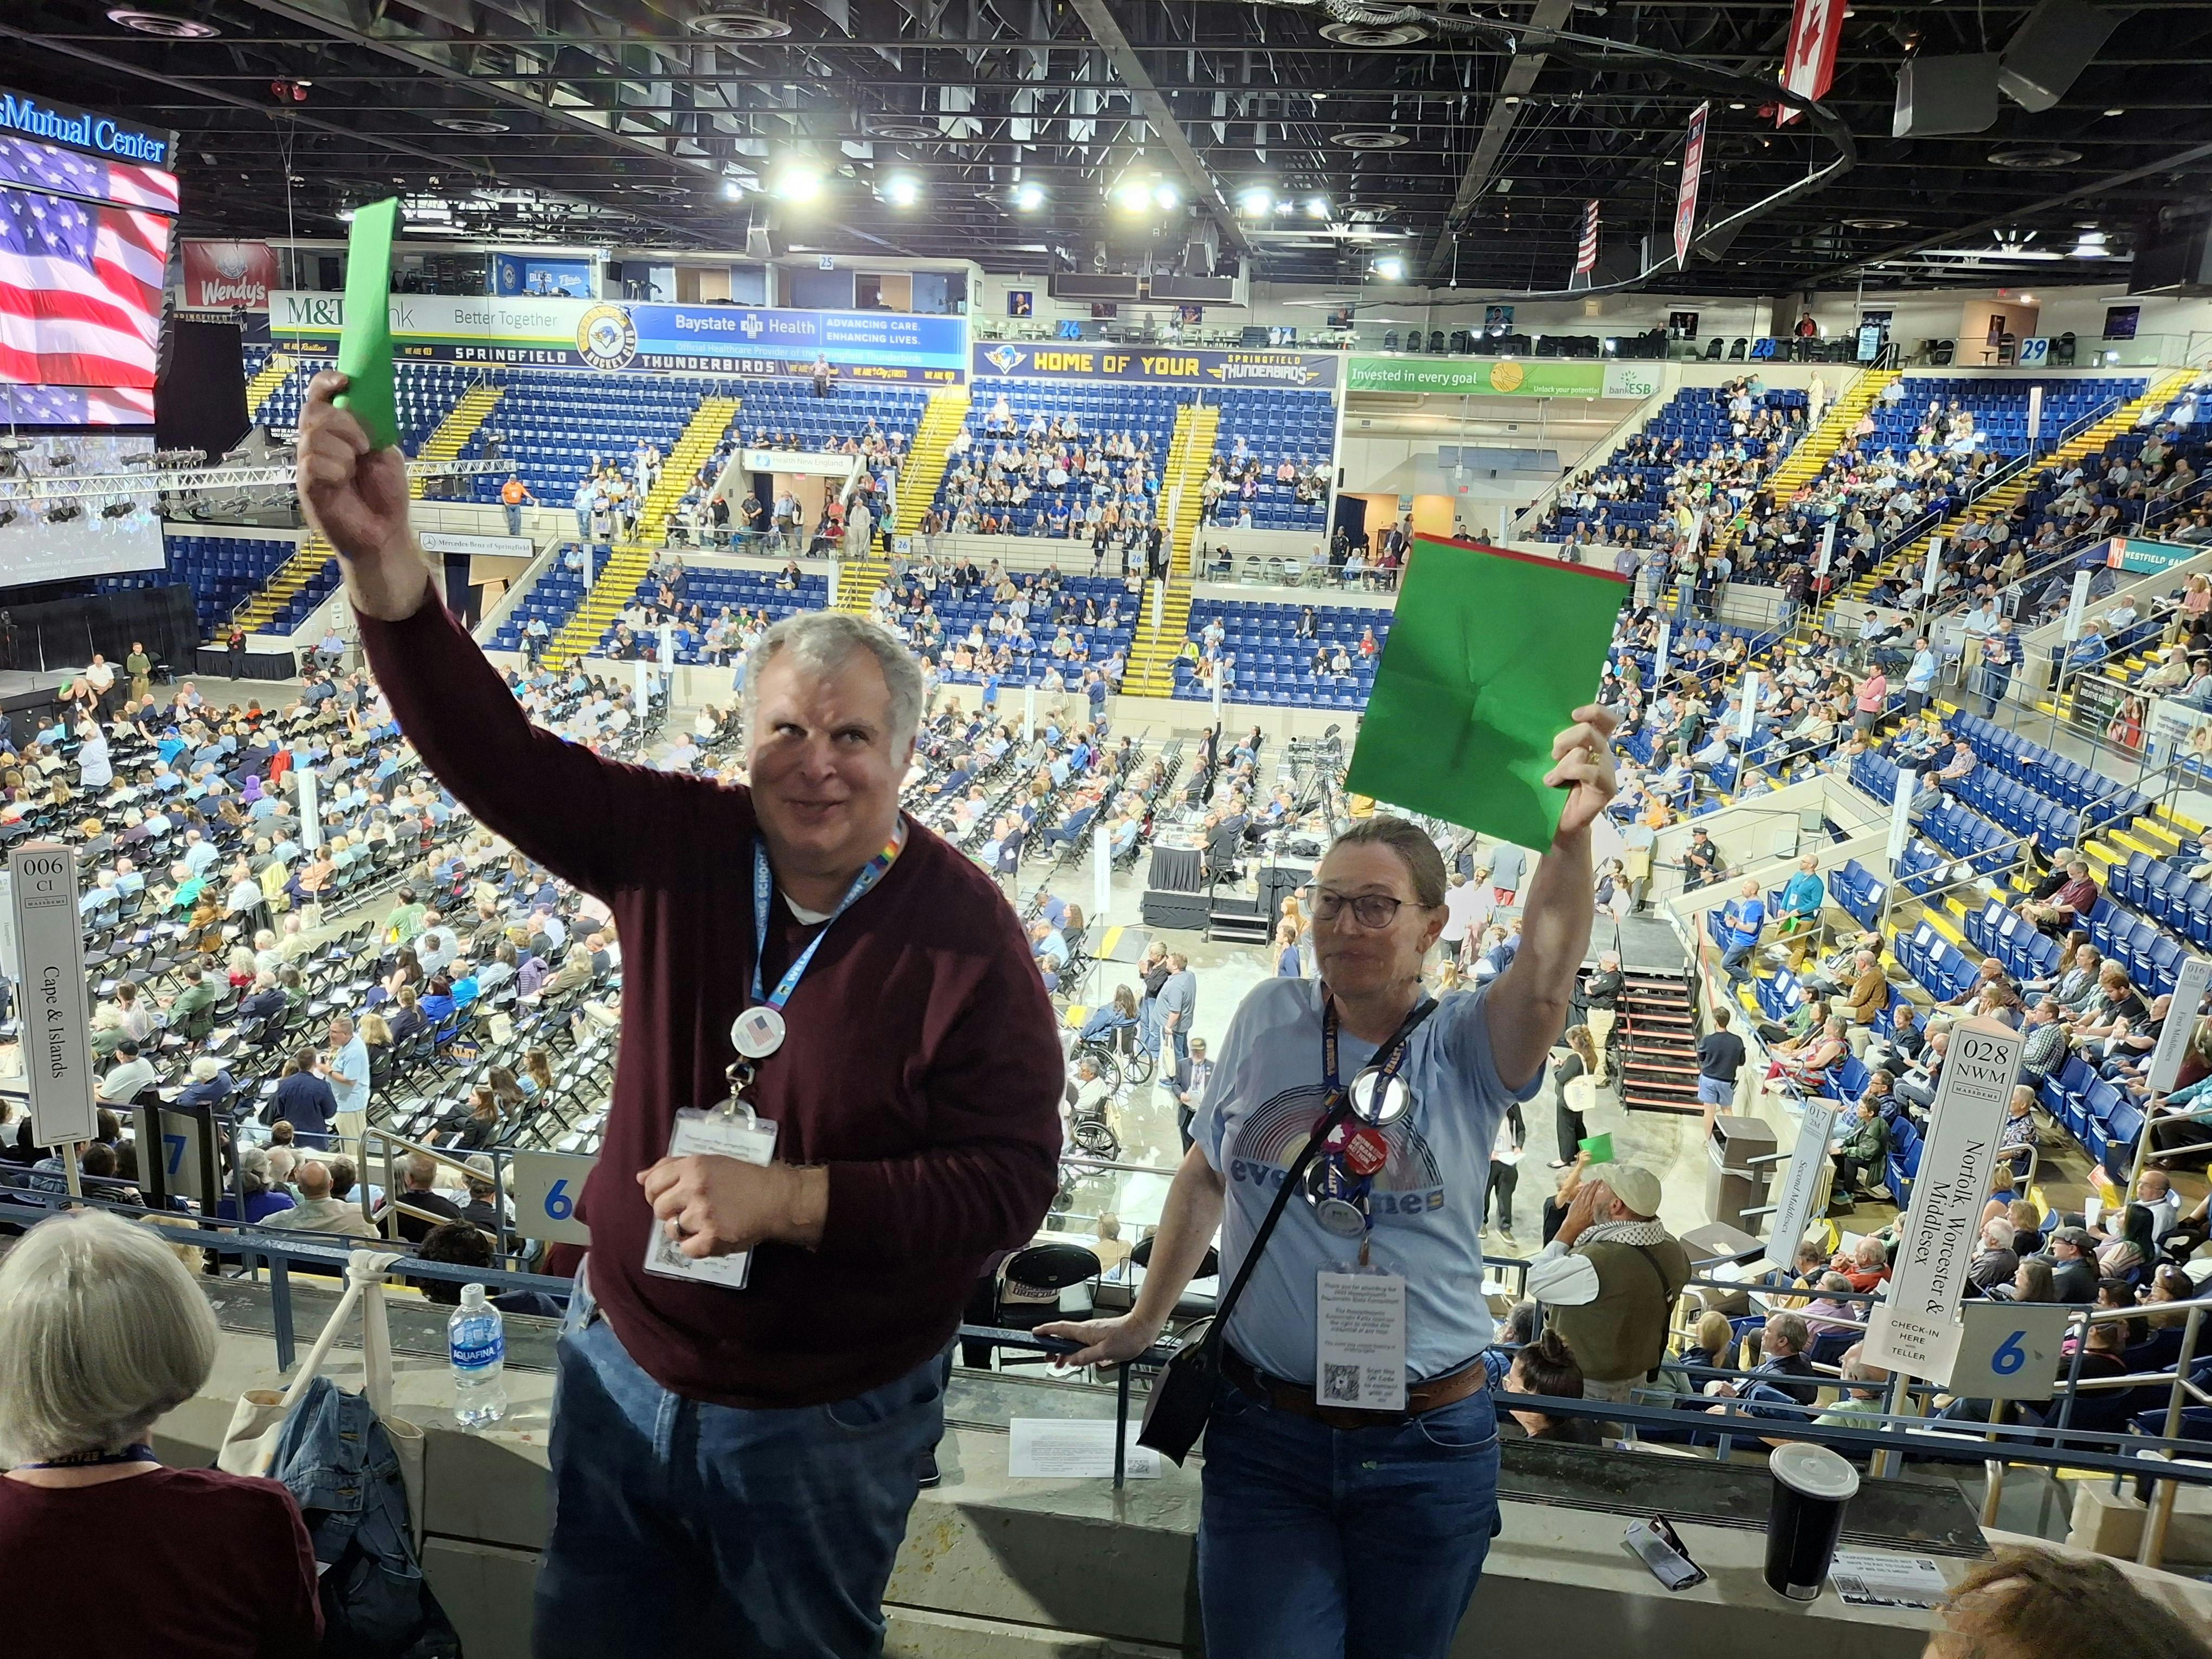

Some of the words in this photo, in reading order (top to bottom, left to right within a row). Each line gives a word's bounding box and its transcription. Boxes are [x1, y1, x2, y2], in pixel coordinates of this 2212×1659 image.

[95, 120, 165, 163] Center
[599, 249, 609, 259] 24
[821, 256, 833, 268] 25
[201, 275, 266, 307] Wendy's
[389, 301, 415, 329] nk
[454, 310, 496, 325] Better
[499, 311, 558, 329] Together
[827, 318, 888, 330] ADVANCING
[676, 314, 736, 333] Baystate
[769, 319, 815, 335] Health
[1060, 320, 1081, 338] 26
[827, 332, 887, 343] ENHANCING
[1270, 326, 1293, 345] 27
[586, 351, 623, 369] HOCKEY
[622, 330, 635, 357] CLUB
[676, 342, 705, 352] Official
[708, 344, 752, 355] Healthcare
[754, 346, 787, 356] Provider
[790, 348, 799, 356] of
[801, 349, 816, 358] the
[866, 353, 922, 363] Thunderbirds
[1751, 338, 1776, 357] 28
[2020, 340, 2047, 360] 29
[455, 347, 567, 364] SPRINGFIELD
[642, 355, 775, 374] THUNDERBIRDS
[1034, 352, 1093, 372] HOME
[1103, 356, 1130, 374] OF
[1141, 357, 1200, 376] YOUR
[1227, 354, 1301, 365] SPRINGFIELD
[862, 368, 872, 376] ARE
[891, 369, 907, 378] FIRSTS
[924, 370, 933, 379] WE
[934, 371, 944, 380] ARE
[1220, 363, 1308, 385] THUNDERBIRDS
[1352, 368, 1401, 381] Invested
[1404, 370, 1415, 382] in
[1418, 373, 1450, 386] every
[1452, 371, 1477, 386] goal
[1534, 385, 1555, 393] Unlock
[1571, 387, 1599, 395] potential
[1609, 383, 1651, 395] bankESB
[773, 456, 796, 465] Health
[814, 458, 843, 467] England
[596, 522, 606, 530] 24
[438, 539, 485, 548] Mercedes-Benz
[494, 542, 530, 551] Springfield
[898, 541, 908, 549] 26
[1131, 555, 1142, 563] 26
[2124, 551, 2166, 564] WESTFIELD
[1779, 606, 1788, 616] 29
[24, 857, 63, 876] 006
[36, 880, 54, 892] CI
[2188, 964, 2205, 975] 016
[41, 966, 60, 1004] Cape
[47, 1009, 63, 1023] &
[2176, 1011, 2186, 1027] First
[48, 1027, 68, 1079] Islands
[1964, 1039, 2009, 1065] 028
[2164, 1027, 2182, 1062] Middlesex
[1956, 1063, 2007, 1085] NWM
[1956, 1086, 1998, 1100] MASSDEMS
[1809, 1105, 1827, 1122] 017
[1810, 1118, 1821, 1130] 2M
[163, 1135, 188, 1175] 7
[1791, 1159, 1808, 1193] Second
[1946, 1139, 1985, 1208] Norfolk,
[544, 1179, 573, 1221] 6
[1781, 1192, 1799, 1234] Middlesex
[1914, 1179, 1951, 1266] Middlesex
[1931, 1217, 1967, 1297] Worcester
[1926, 1299, 1944, 1315] &
[1891, 1320, 1940, 1338] CHECK-IN
[1899, 1333, 1926, 1345] HERE
[453, 1346, 496, 1362] AQUAFINA
[1892, 1347, 1926, 1361] TELLER
[1991, 1330, 2027, 1376] 6
